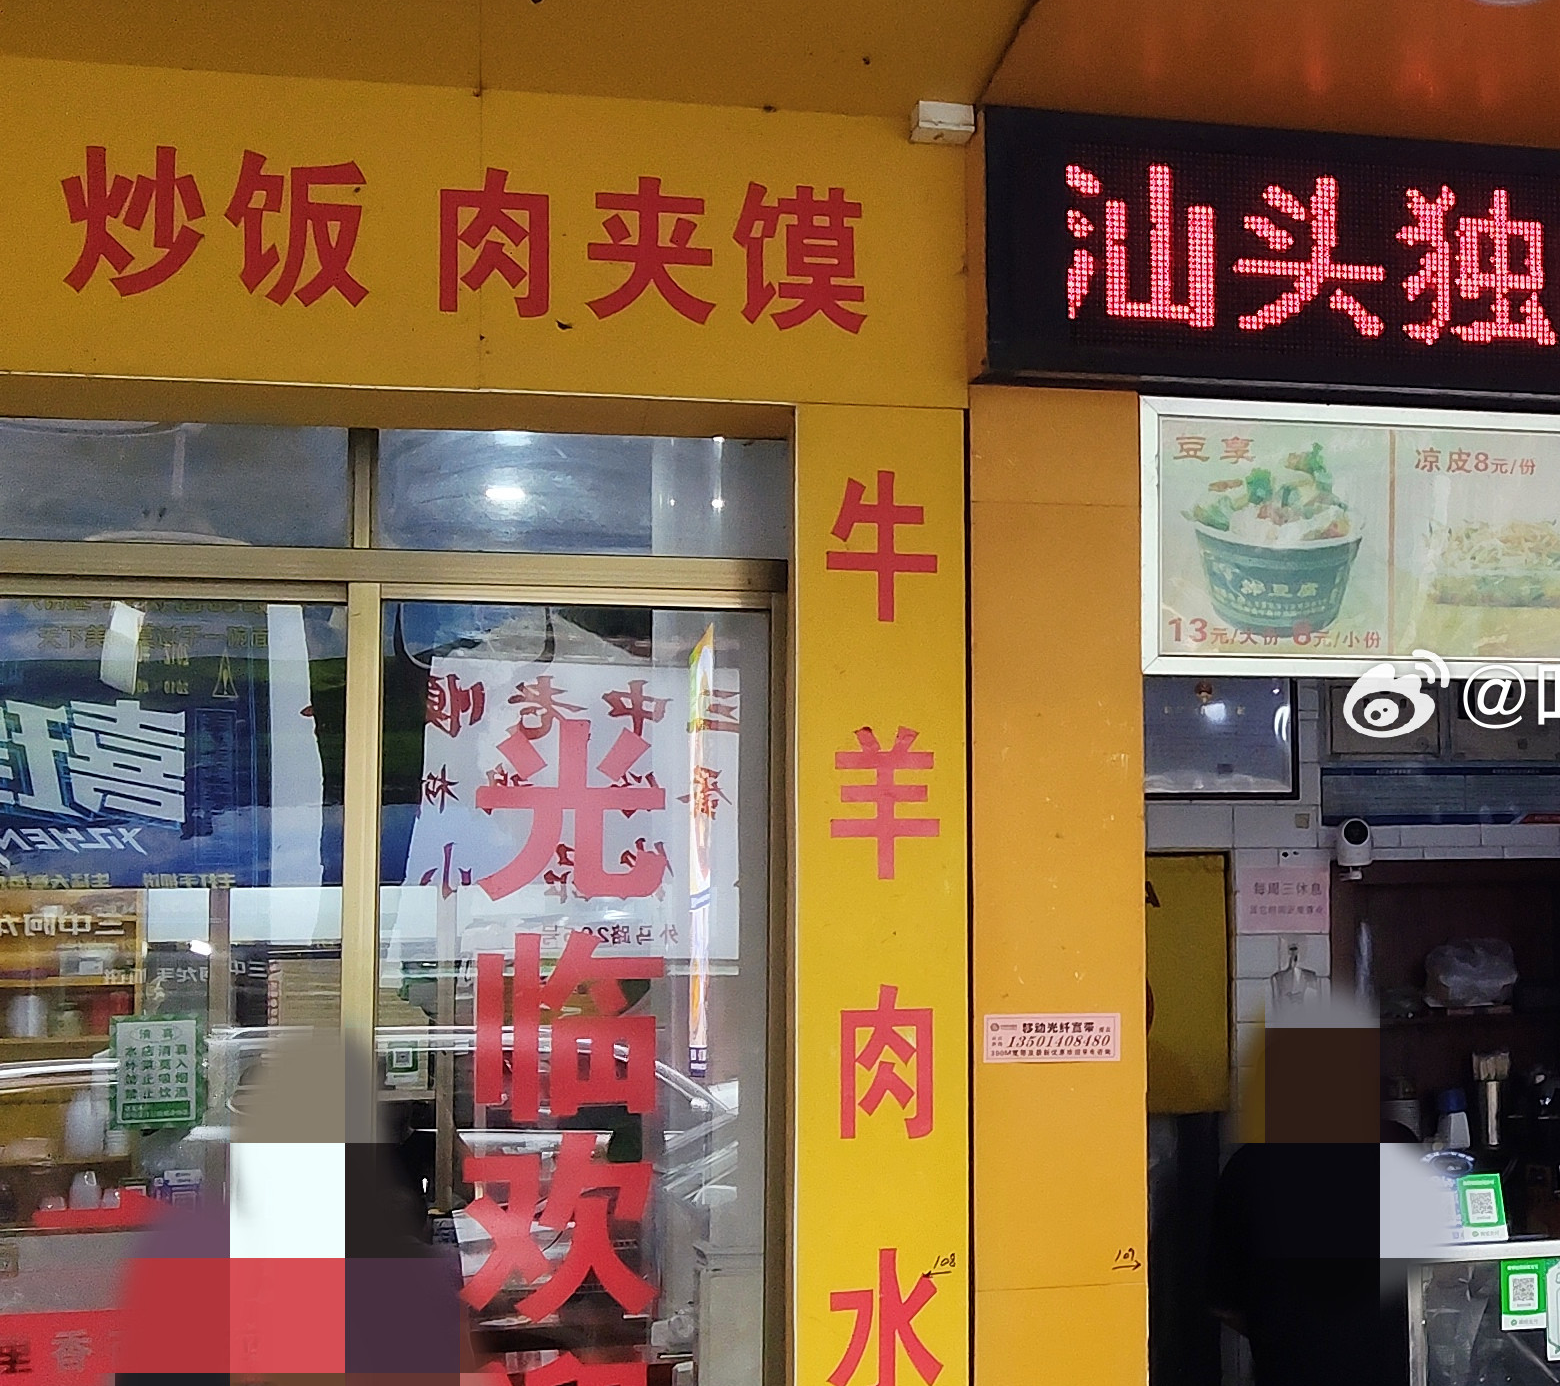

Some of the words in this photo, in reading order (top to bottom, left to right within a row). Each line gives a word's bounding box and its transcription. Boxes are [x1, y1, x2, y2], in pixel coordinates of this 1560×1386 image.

[61, 144, 370, 308] 炒饭
[437, 166, 868, 335] 肉夹馍
[1173, 435, 1257, 464] 豆享
[1414, 446, 1537, 476] 凉皮8元/份
